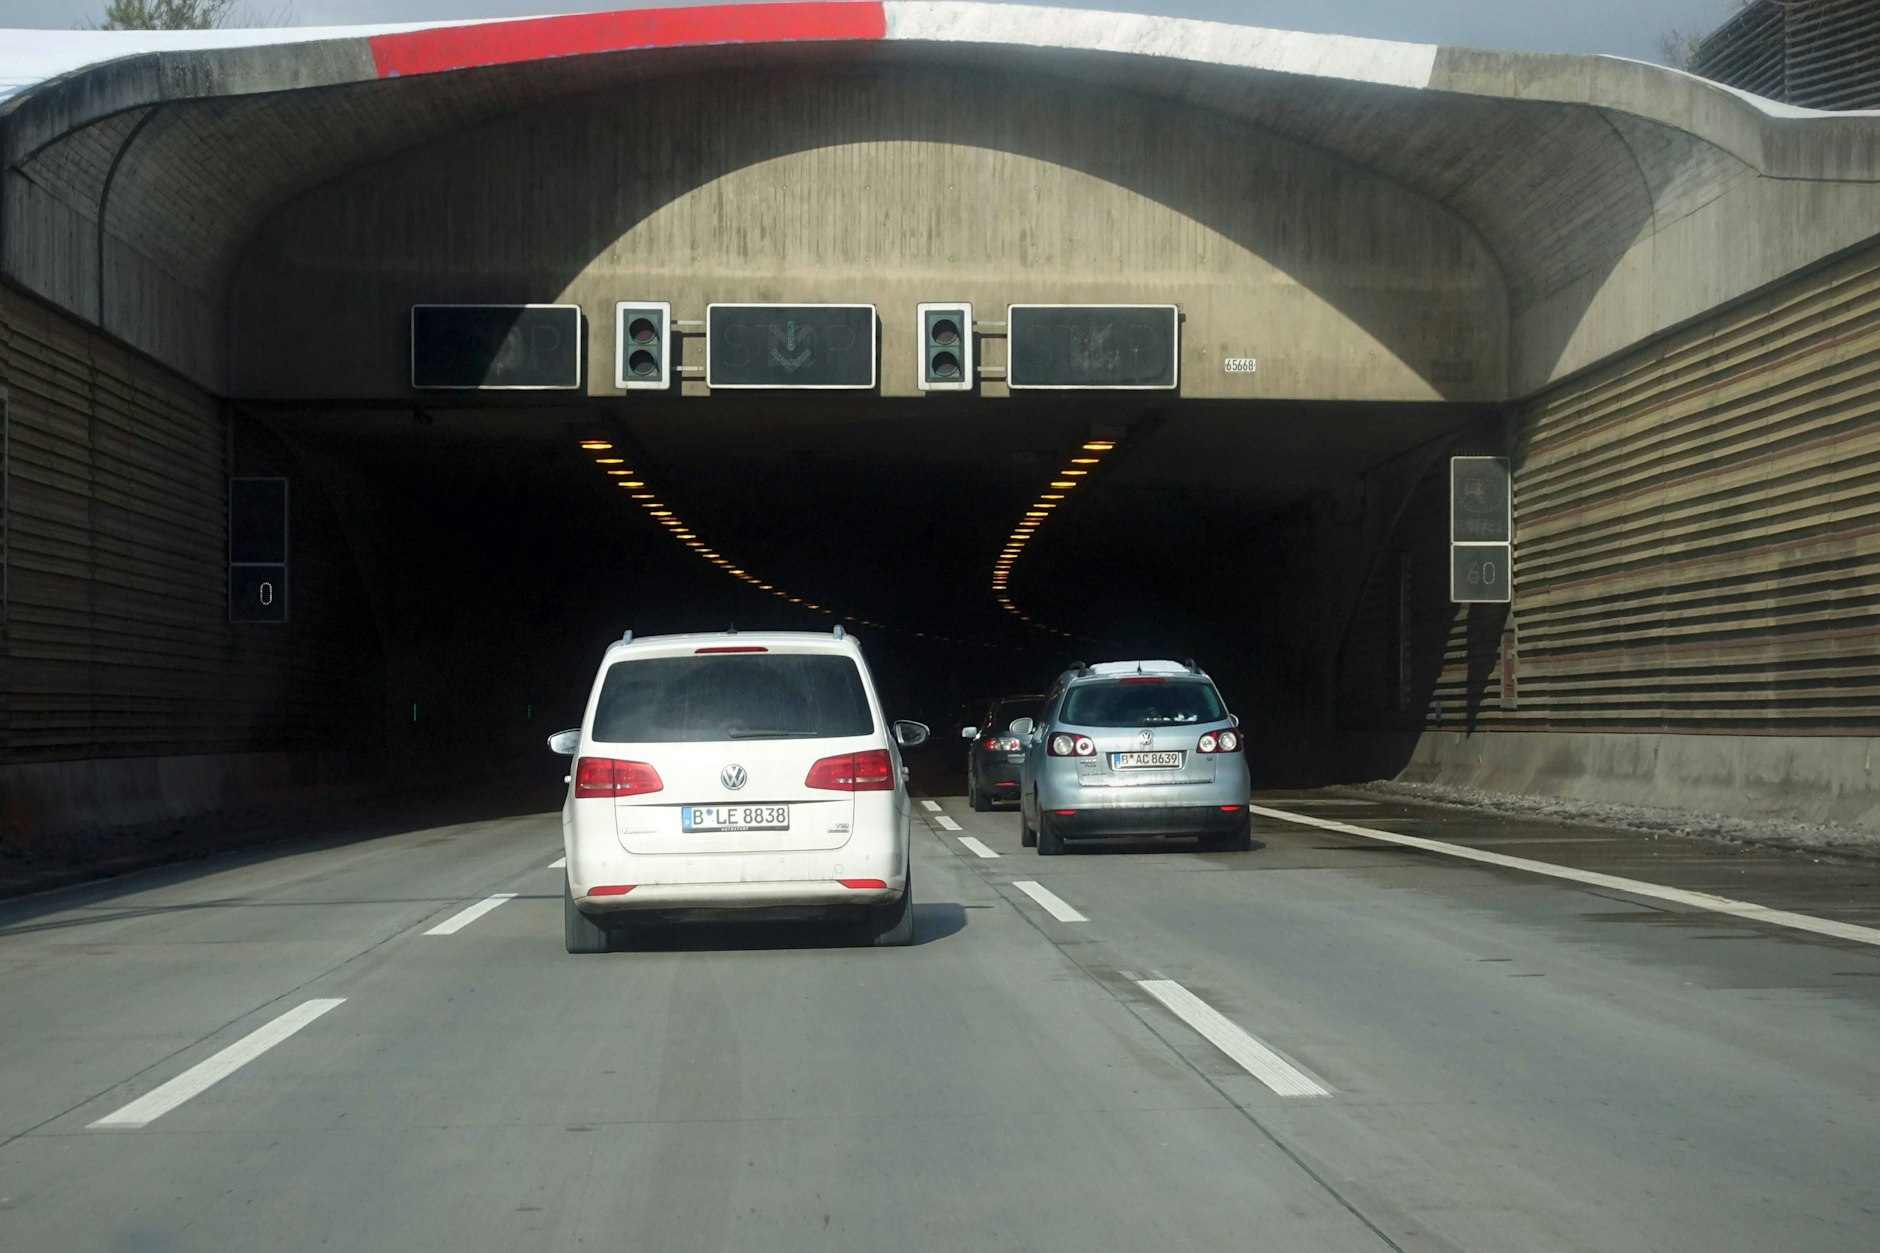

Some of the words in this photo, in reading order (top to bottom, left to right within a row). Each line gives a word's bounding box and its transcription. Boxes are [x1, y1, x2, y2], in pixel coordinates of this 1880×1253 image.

[1226, 359, 1254, 371] 65668
[259, 582, 273, 606] 0
[1121, 754, 1129, 764] B
[1136, 754, 1149, 764] AC
[1151, 753, 1178, 764] 8639
[693, 809, 704, 825] B
[716, 808, 738, 824] LE
[743, 807, 786, 824] 8838
